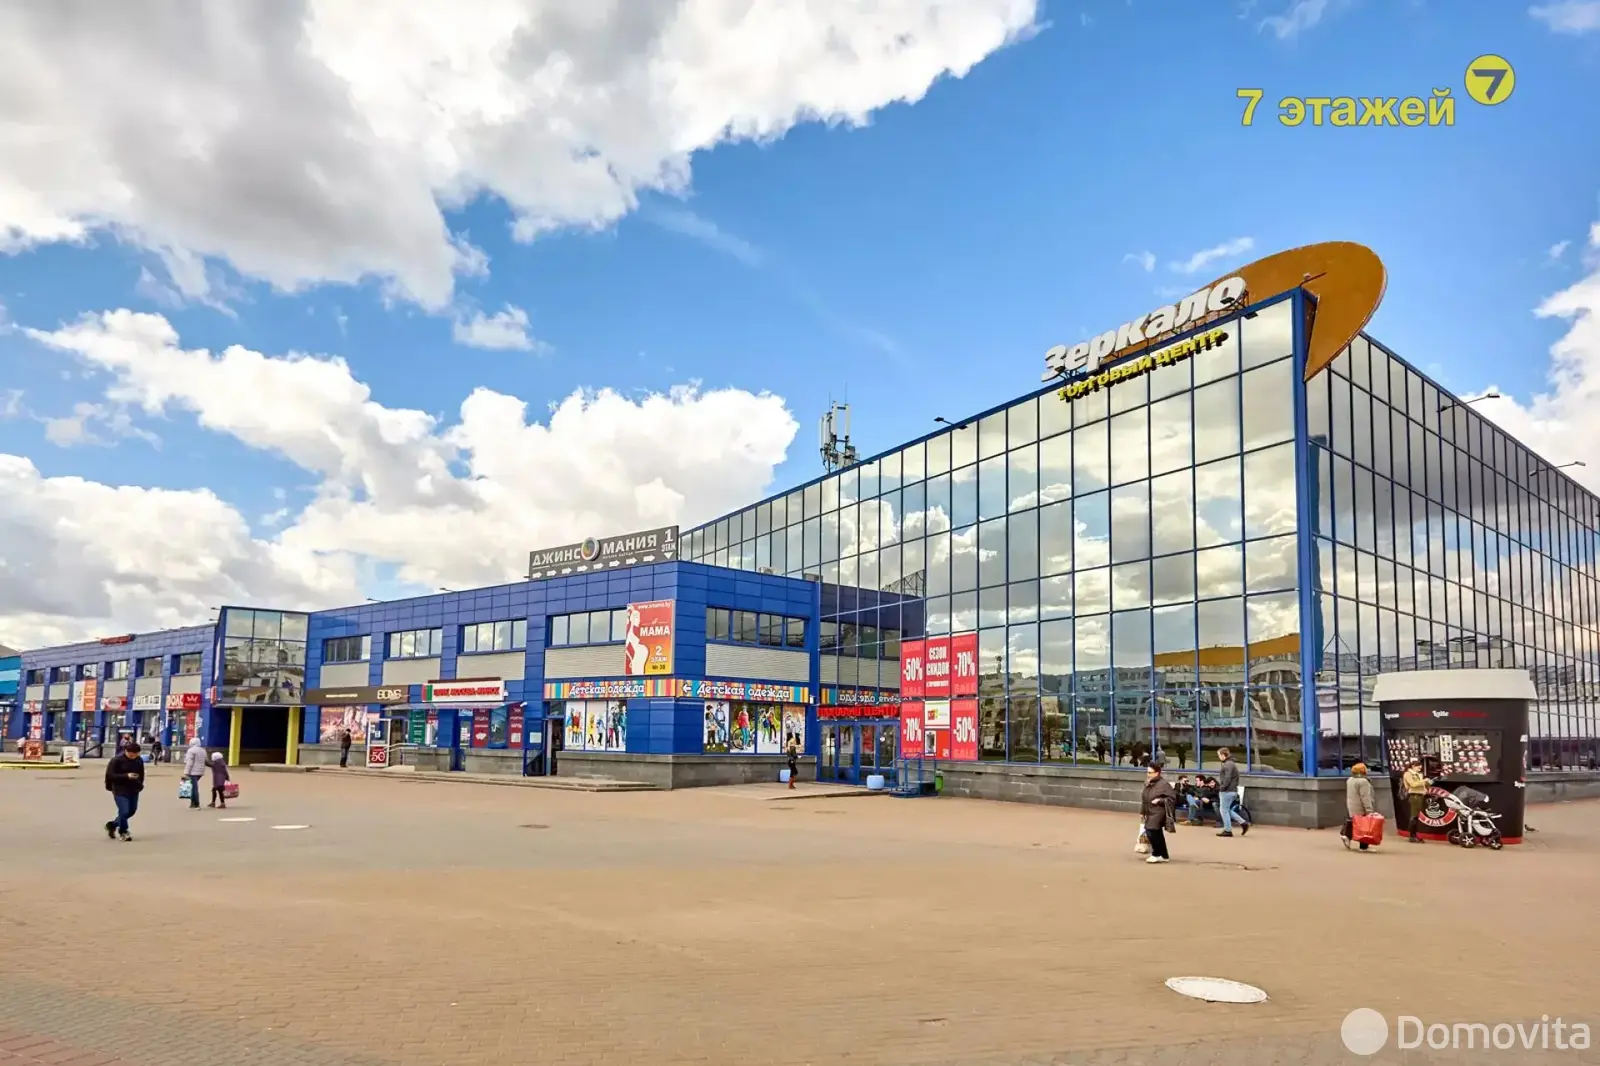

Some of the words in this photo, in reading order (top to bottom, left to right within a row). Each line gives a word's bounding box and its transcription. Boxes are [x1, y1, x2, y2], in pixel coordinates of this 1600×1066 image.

[1057, 355, 1155, 402] ТОРГОВЫЙ
[1155, 328, 1226, 367] ЦЕНТР
[664, 528, 674, 543] 1
[640, 626, 671, 637] МАМА
[655, 646, 662, 656] 2
[903, 657, 923, 681] -50%
[954, 652, 975, 677] -70%
[568, 681, 606, 698] Детская
[607, 680, 645, 696] одежда
[697, 680, 745, 696] Детская
[747, 687, 790, 700] одежда
[903, 718, 922, 742] -70%
[954, 716, 975, 743] -50%
